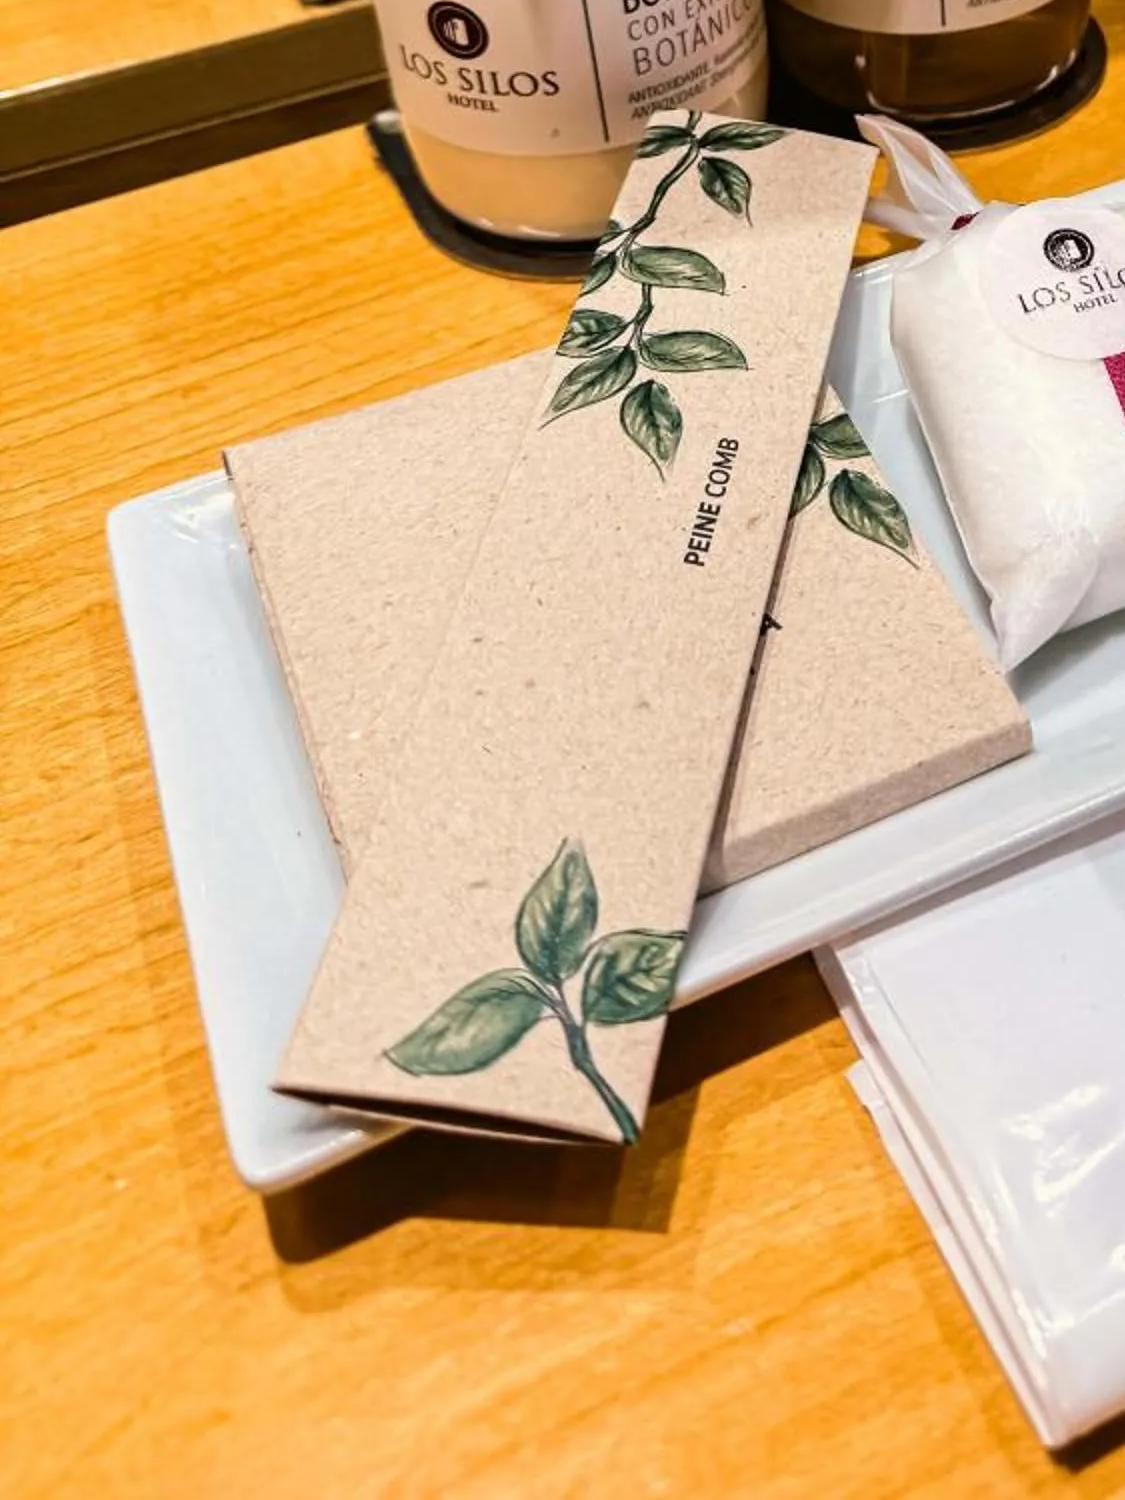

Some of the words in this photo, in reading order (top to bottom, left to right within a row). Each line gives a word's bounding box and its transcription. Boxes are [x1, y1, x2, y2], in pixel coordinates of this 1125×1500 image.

[627, 8, 675, 41] CON
[398, 42, 448, 85] LOS
[458, 67, 561, 98] SILOS
[447, 91, 498, 113] HOTEL
[1017, 281, 1072, 315] LOS
[1073, 294, 1119, 314] HOTEL
[683, 501, 722, 567] PEINE
[704, 436, 740, 498] COMB
